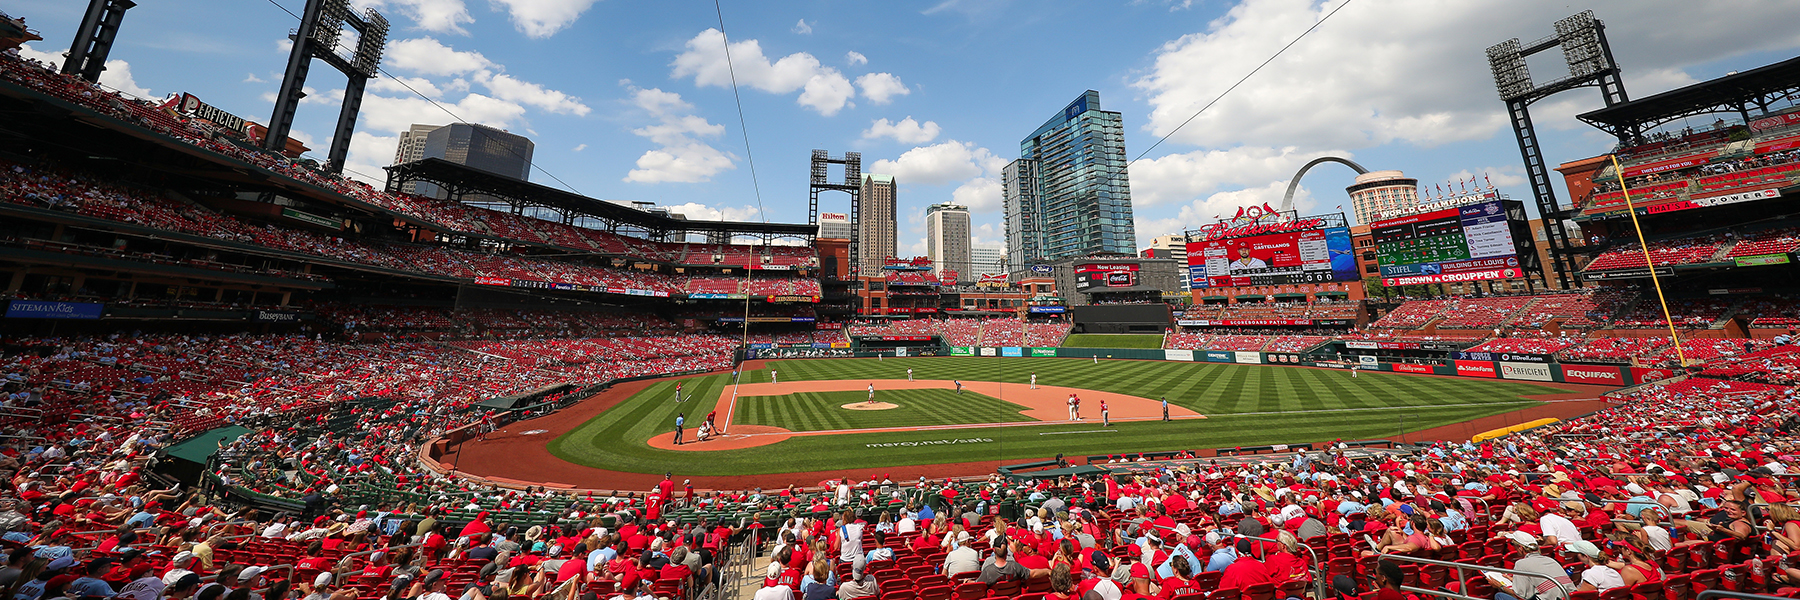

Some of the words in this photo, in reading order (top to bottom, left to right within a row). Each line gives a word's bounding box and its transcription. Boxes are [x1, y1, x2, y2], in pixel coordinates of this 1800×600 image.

[182, 94, 247, 133] PERFICIENT
[1380, 206, 1415, 218] WORLD
[1418, 194, 1485, 211] CHAMPIONS
[1649, 203, 1680, 213] THAT'S
[1710, 192, 1761, 204] POWER
[1200, 216, 1323, 241] Budweiser
[1388, 265, 1412, 274] STIFEL
[1442, 261, 1472, 270] BUILDING
[1110, 274, 1128, 282] Coca-Cola
[1399, 275, 1433, 285] BROWN
[1441, 270, 1500, 281] CROUPPEN
[1502, 365, 1548, 376] PERFICIENT
[1567, 369, 1617, 379] EQUIFAX
[866, 438, 994, 448] mercy.net/safe
[651, 499, 657, 508] 7
